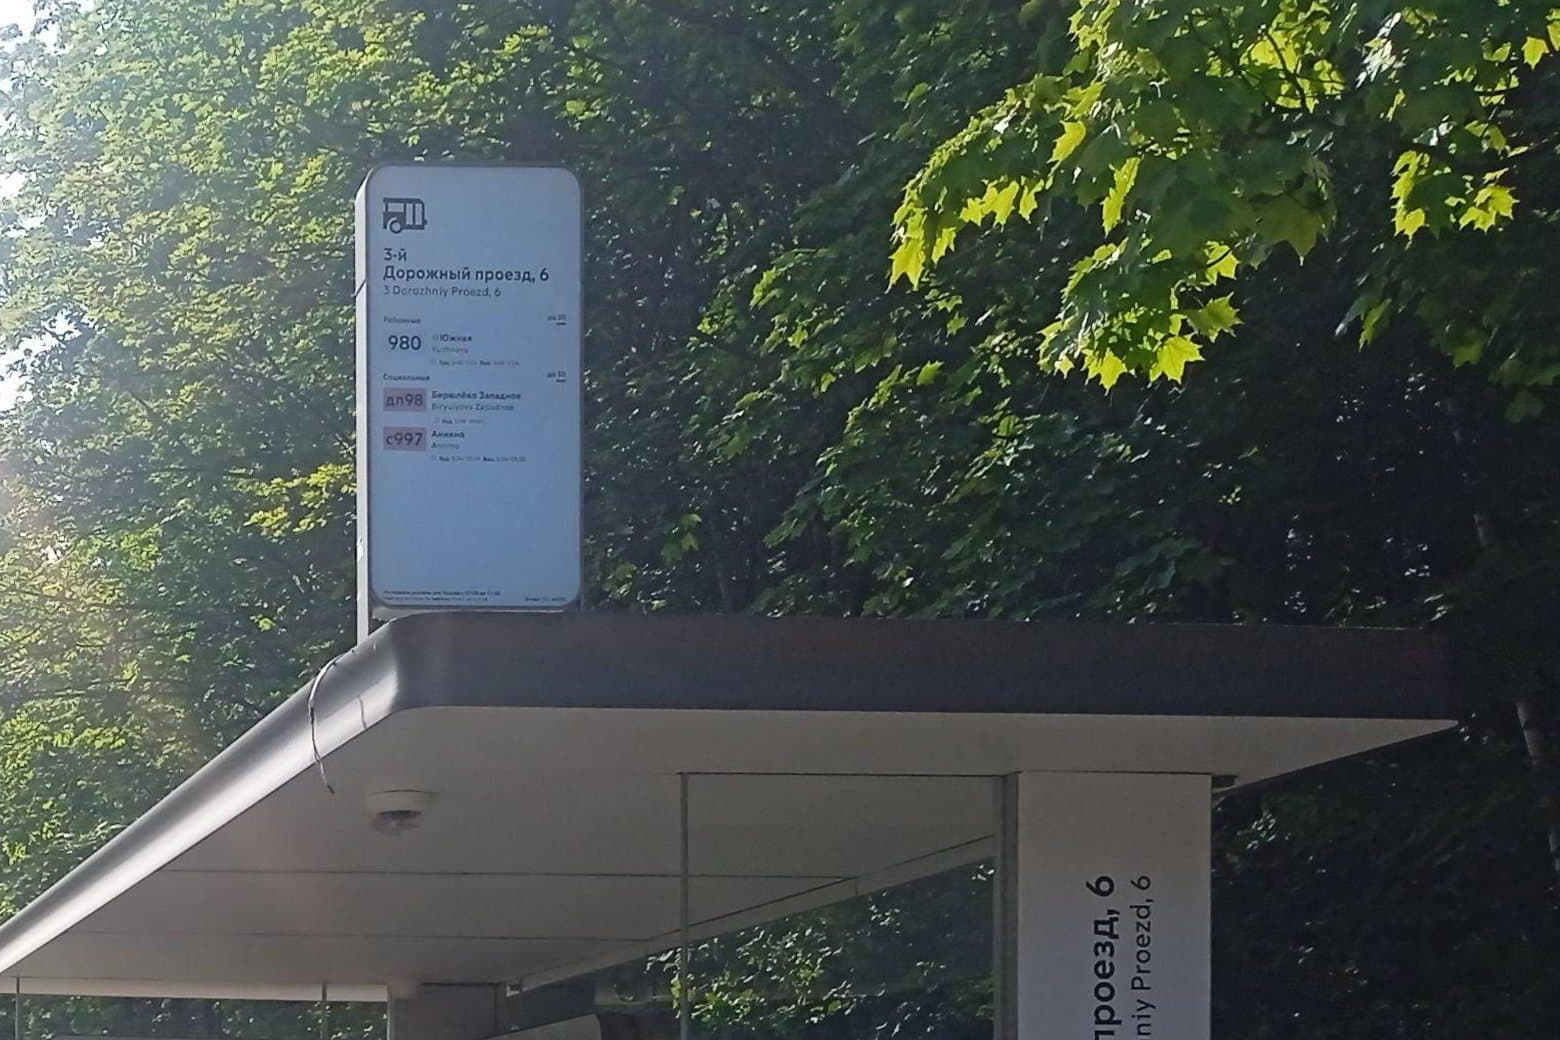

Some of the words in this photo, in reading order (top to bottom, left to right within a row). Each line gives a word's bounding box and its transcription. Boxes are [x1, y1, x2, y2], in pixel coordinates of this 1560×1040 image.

[383, 247, 407, 262] 3-й
[383, 265, 471, 282] Дорожный
[475, 268, 536, 284] проезд,
[540, 267, 550, 281] 6
[383, 285, 390, 296] 3
[392, 285, 448, 298] Dorozhniy
[494, 287, 502, 297] 6
[387, 335, 422, 350] 980
[385, 393, 424, 408] дп98
[385, 432, 424, 446] с997
[1086, 875, 1116, 898] 6
[1131, 875, 1151, 892] 6
[1130, 898, 1154, 991] Proezd,
